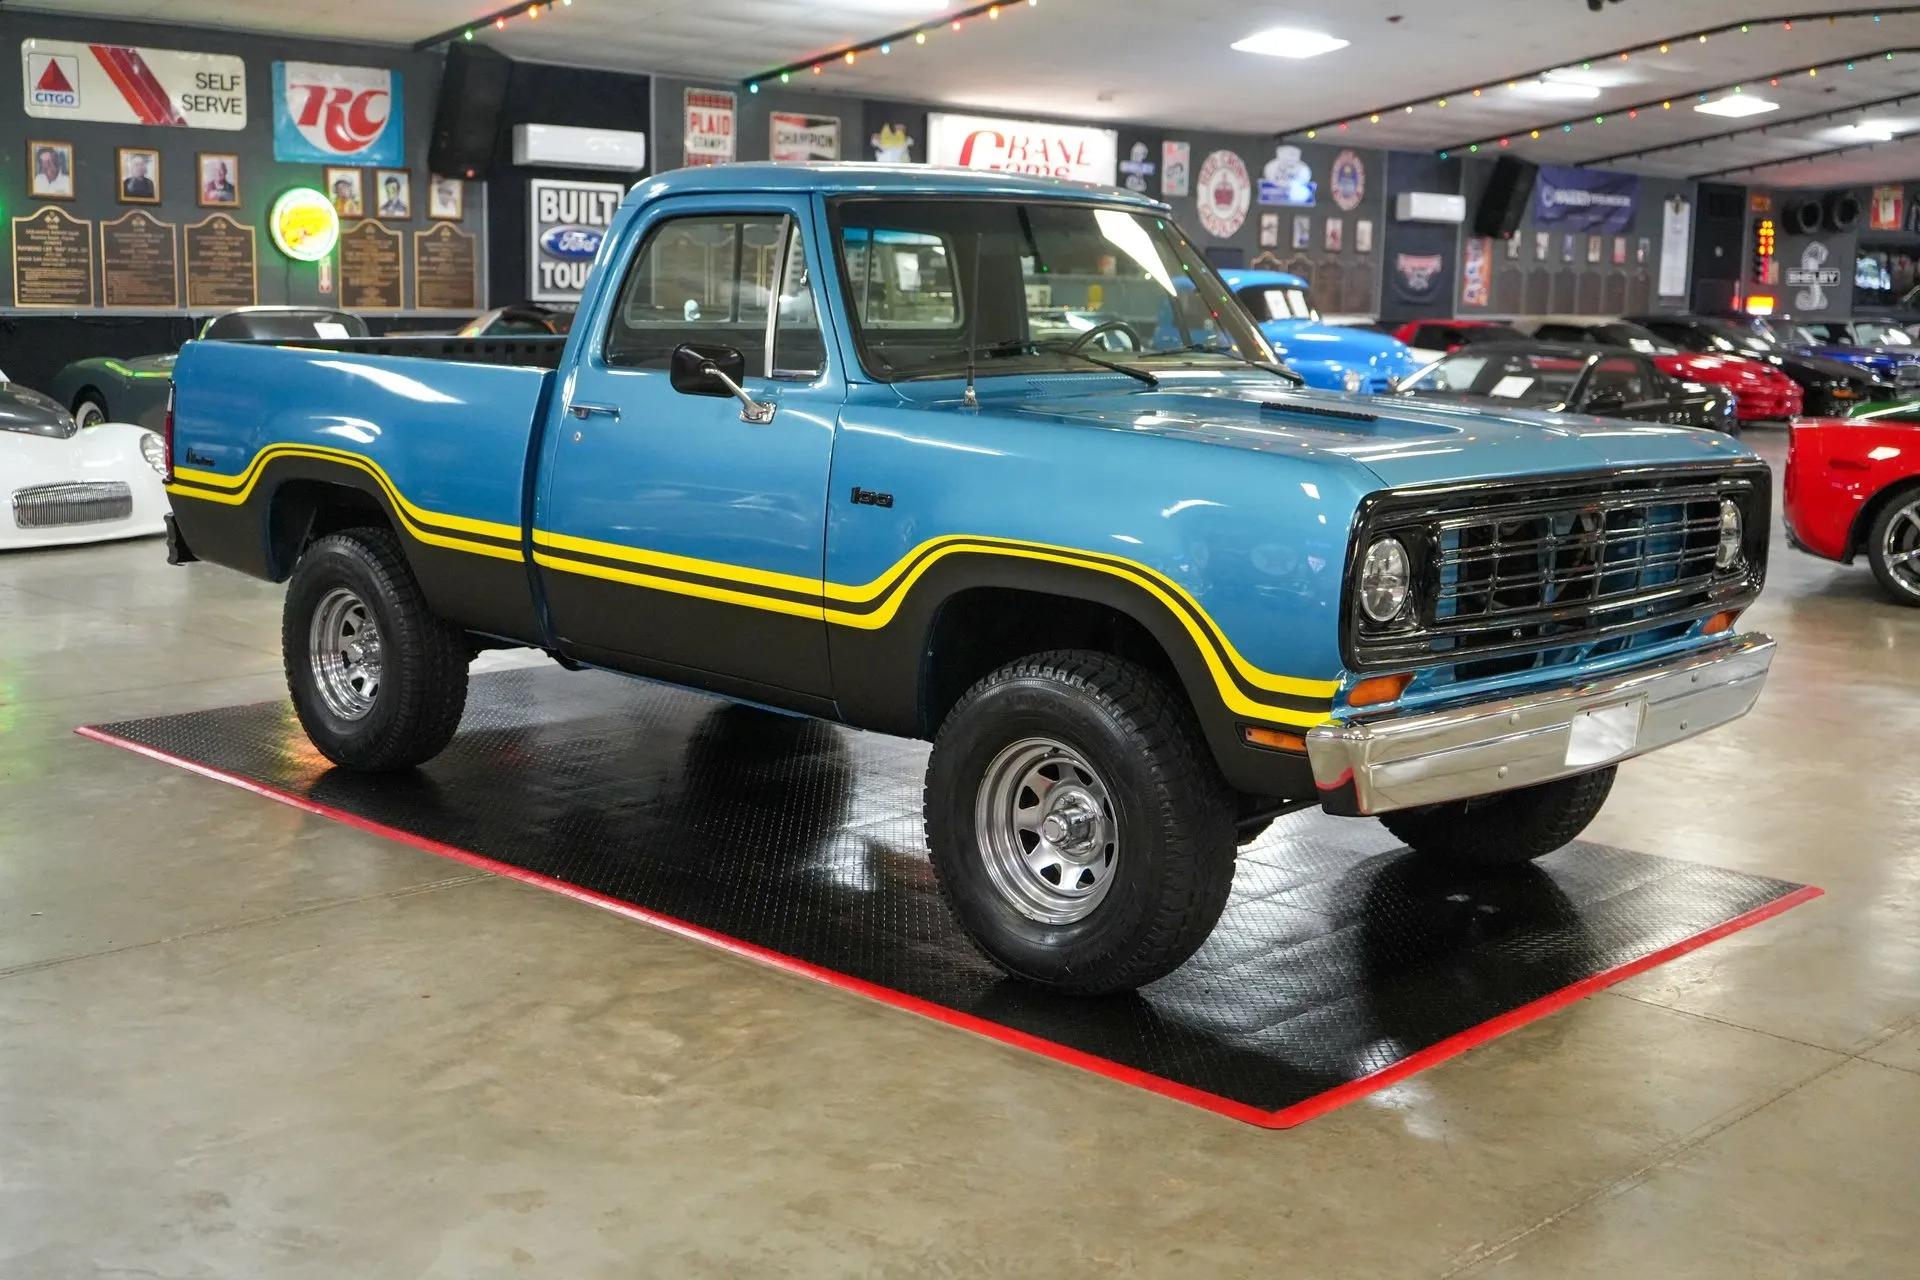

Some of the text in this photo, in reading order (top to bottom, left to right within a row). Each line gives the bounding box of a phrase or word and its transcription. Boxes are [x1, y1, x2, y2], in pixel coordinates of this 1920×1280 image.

[195, 72, 241, 91] SELF
[35, 92, 75, 105] CITGO
[181, 94, 243, 115] SERVE
[289, 83, 389, 153] RC
[690, 111, 731, 136] PLAID
[777, 131, 835, 148] CHAMPION
[540, 189, 618, 225] BUILT
[558, 231, 600, 252] Ford
[540, 261, 594, 290] TOU
